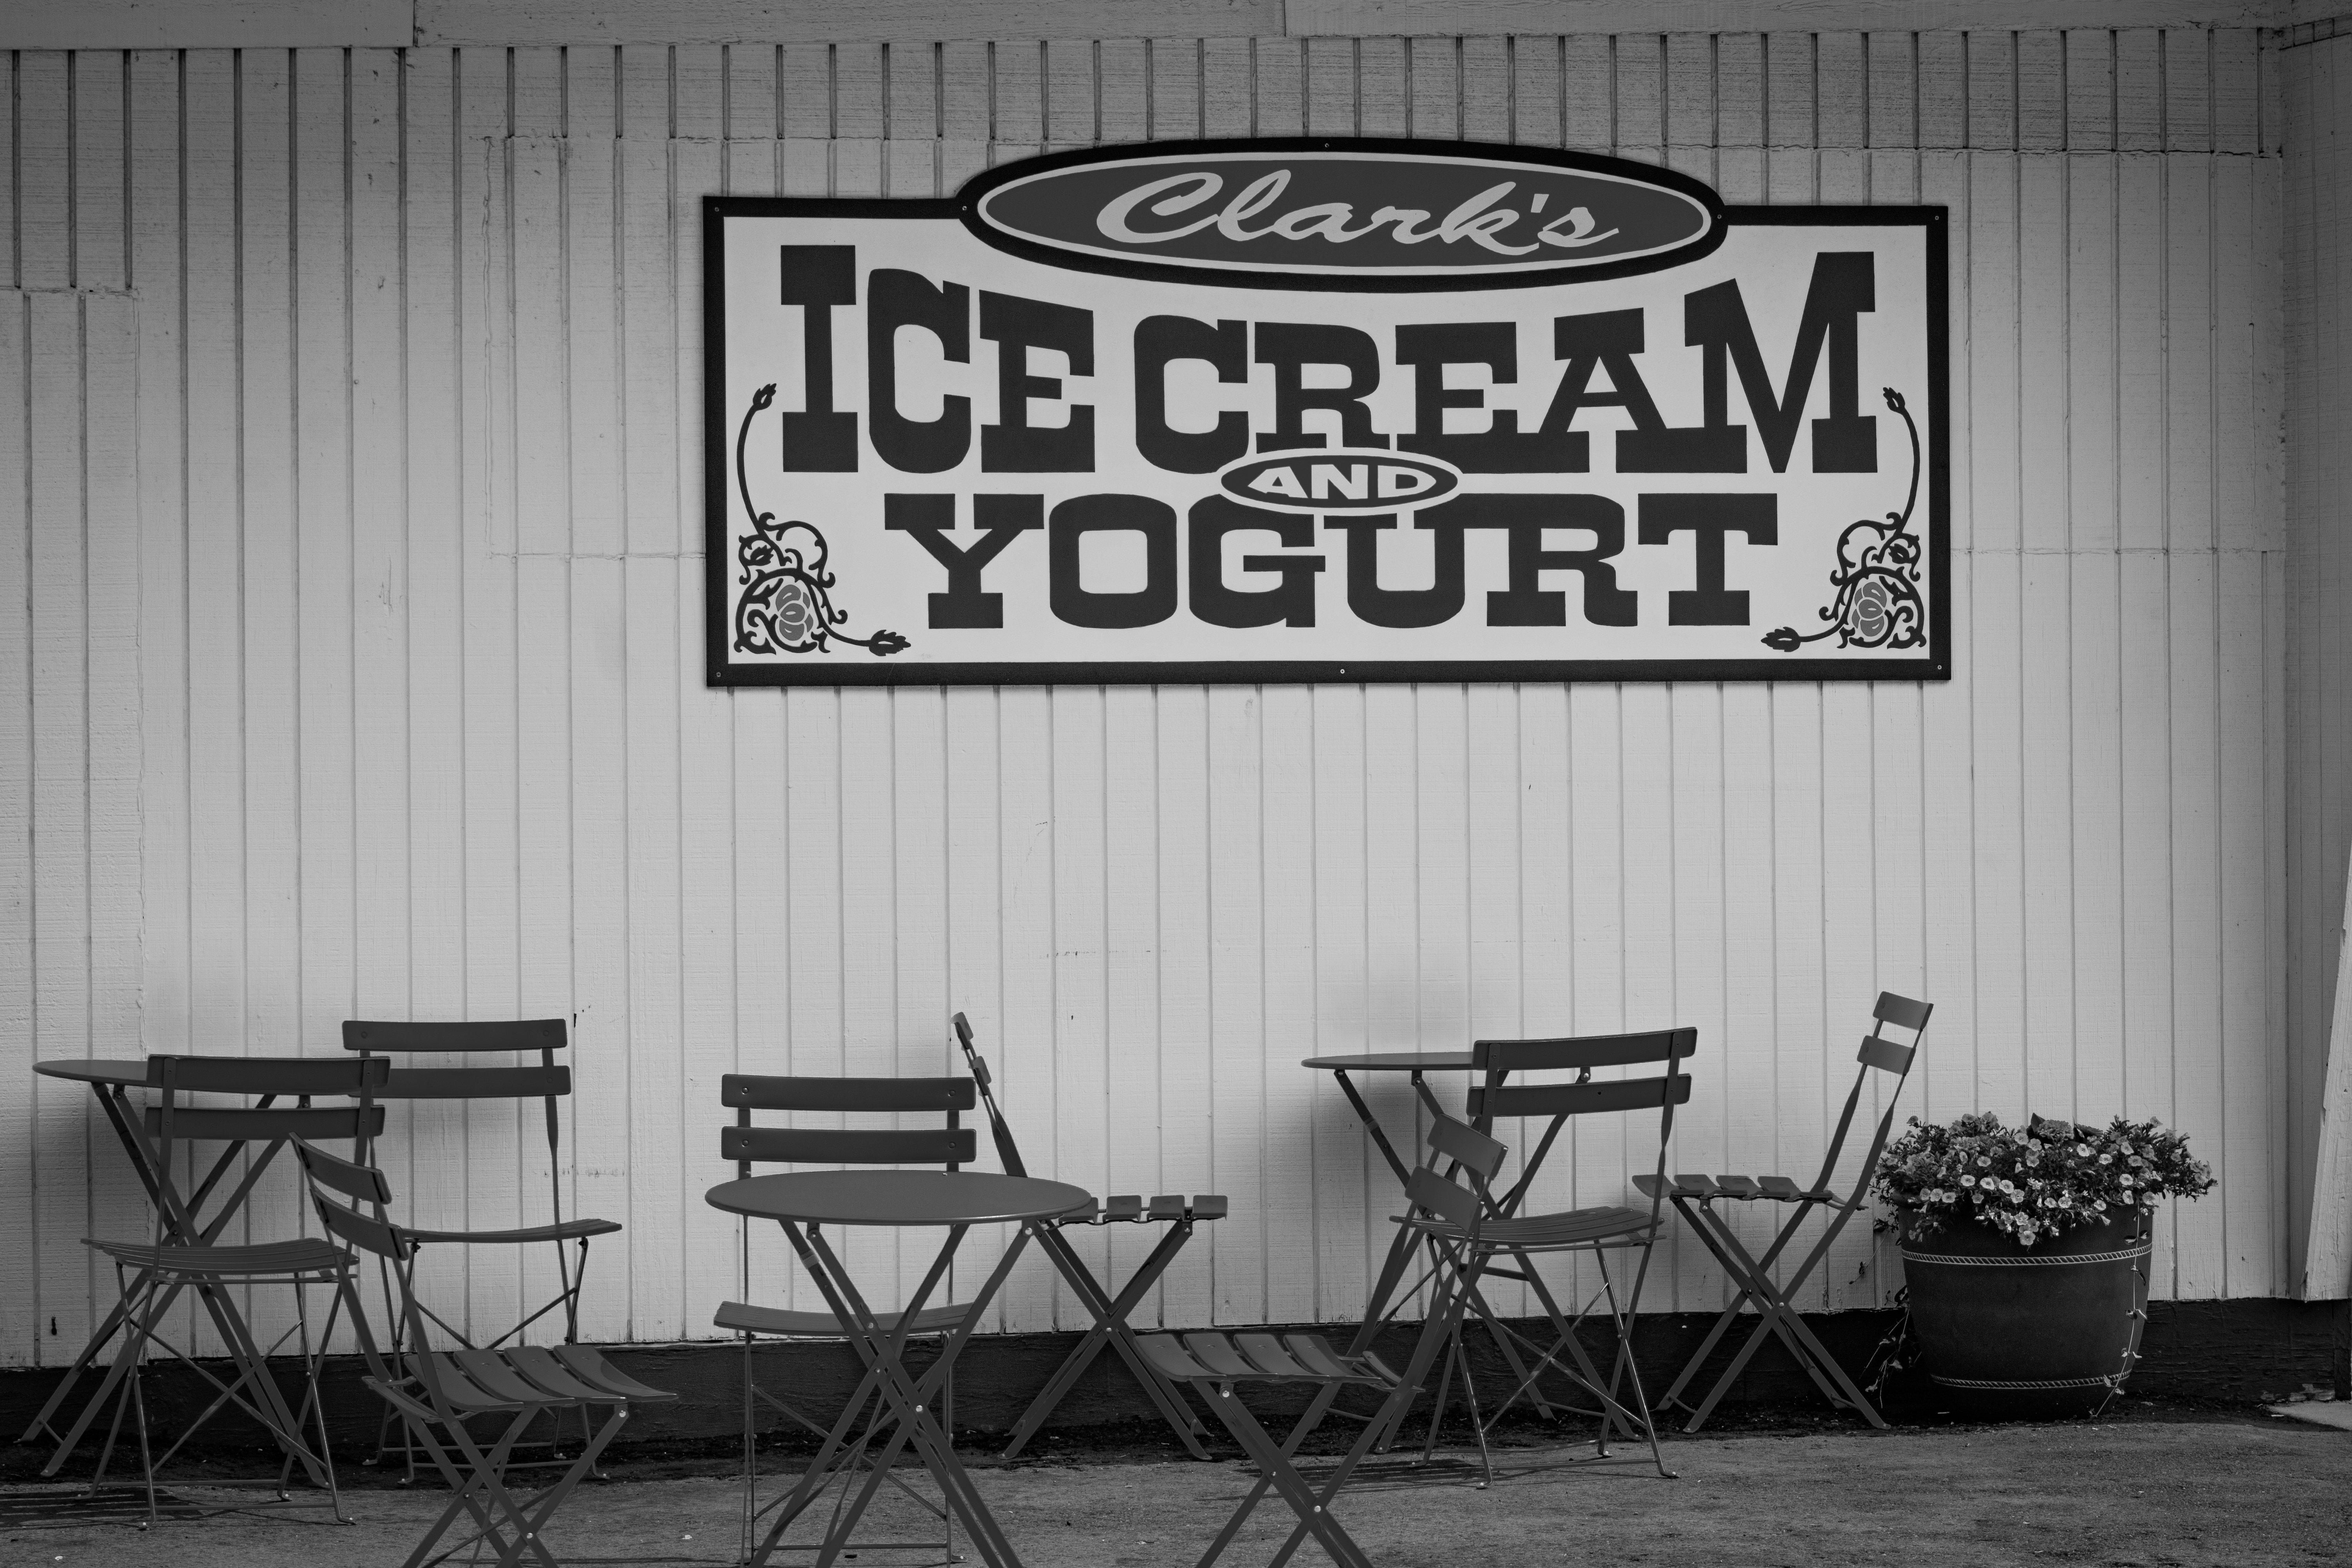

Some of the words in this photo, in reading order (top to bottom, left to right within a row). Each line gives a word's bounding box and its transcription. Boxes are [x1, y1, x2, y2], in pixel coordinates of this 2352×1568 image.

[1097, 170, 1619, 256] Clark's
[781, 245, 1095, 473] ICE
[1134, 252, 1877, 474] CREAM
[1248, 465, 1436, 499] AND
[884, 494, 1778, 629] YOGURT
